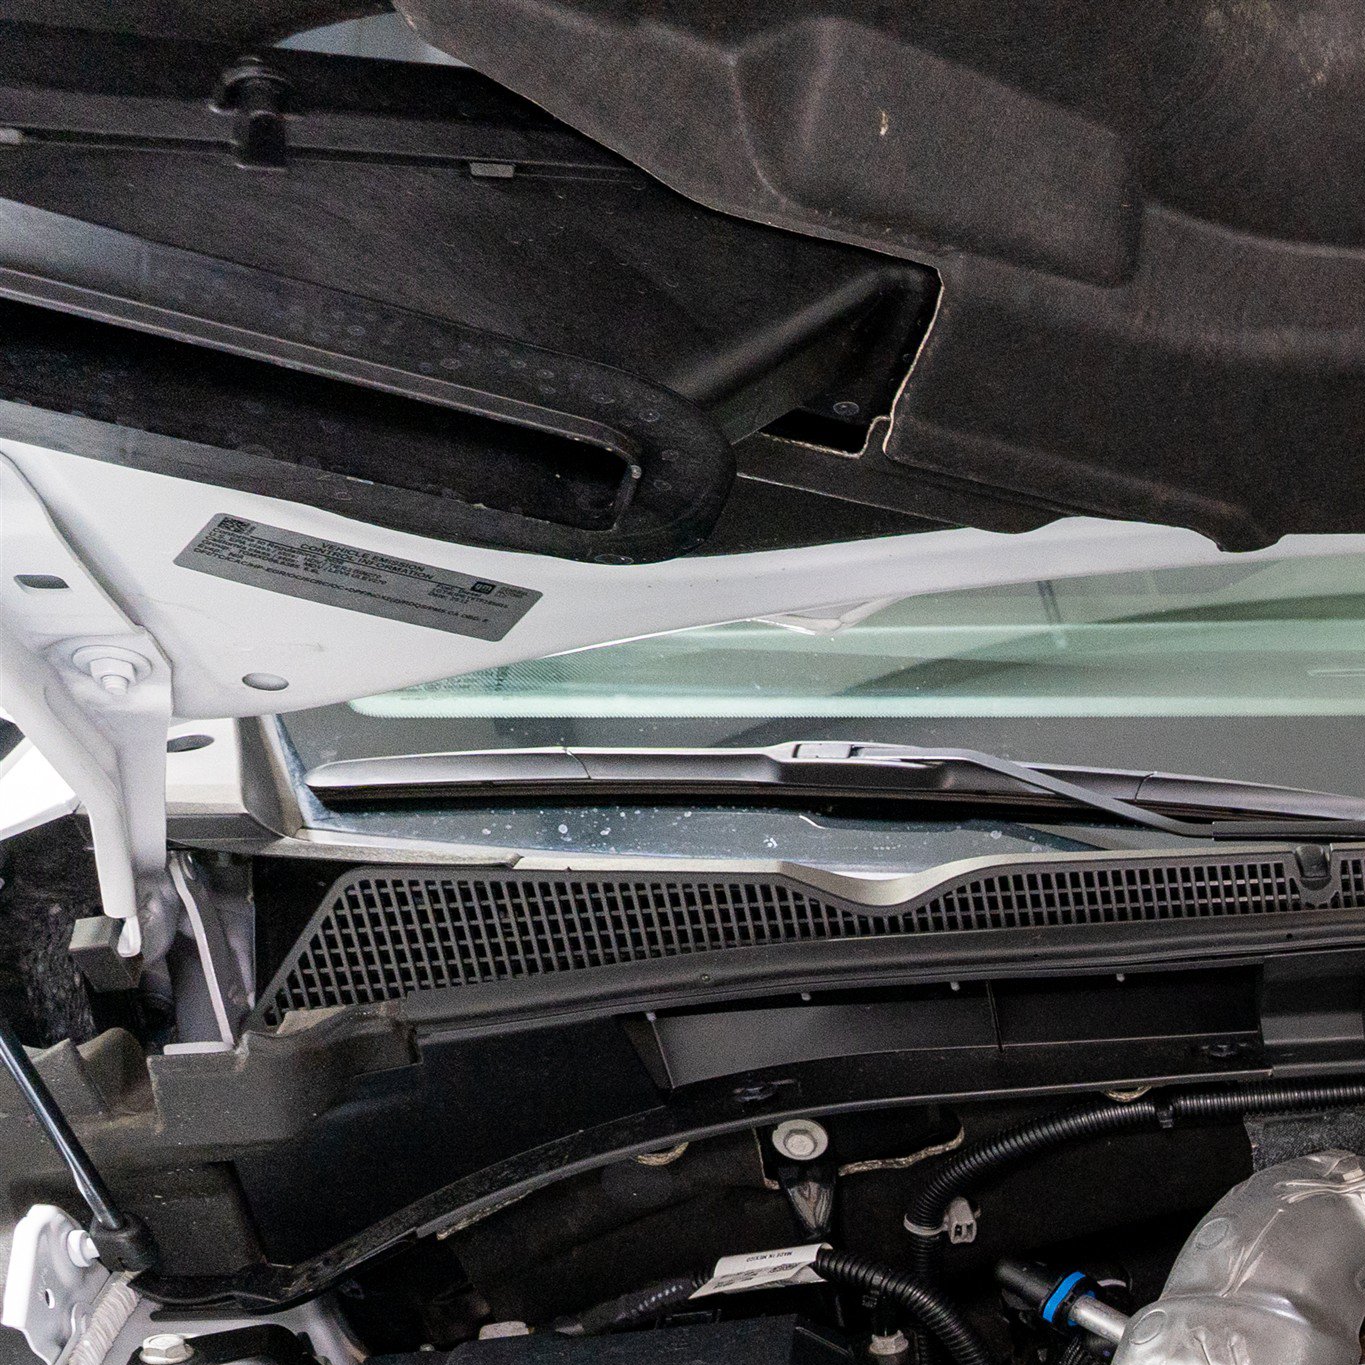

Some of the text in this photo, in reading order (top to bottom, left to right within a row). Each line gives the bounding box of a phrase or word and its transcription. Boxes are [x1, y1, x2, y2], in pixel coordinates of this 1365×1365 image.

[300, 543, 436, 580] CONTROL INFORMATION
[322, 542, 425, 573] VEHICLE EMISSION
[746, 1254, 768, 1263] MEXICO
[776, 1251, 794, 1259] MADE
